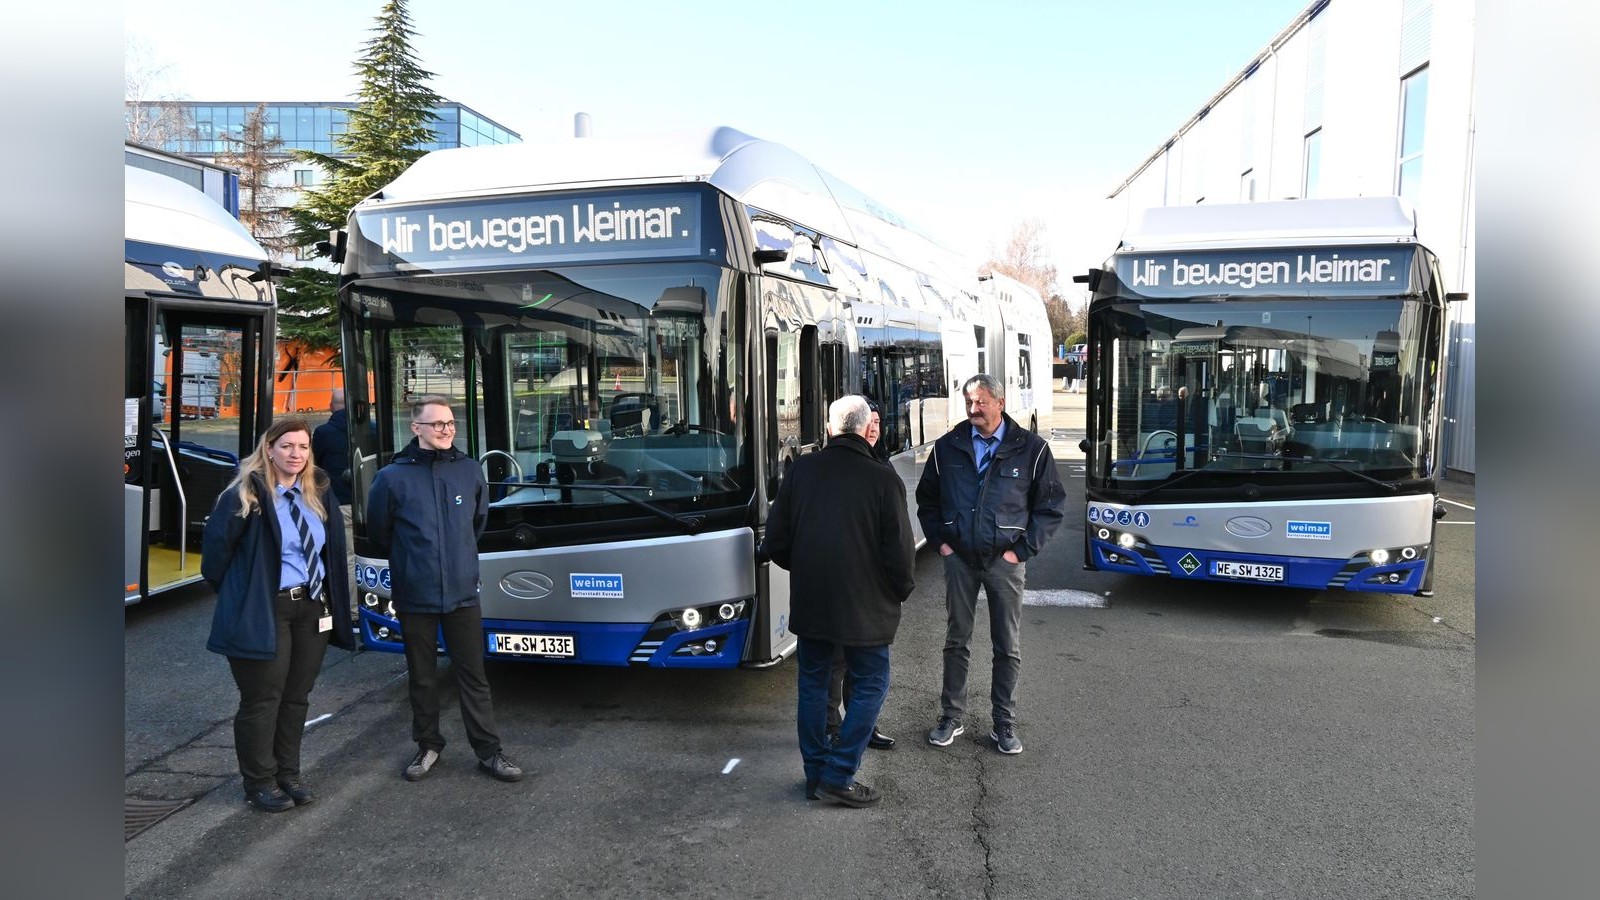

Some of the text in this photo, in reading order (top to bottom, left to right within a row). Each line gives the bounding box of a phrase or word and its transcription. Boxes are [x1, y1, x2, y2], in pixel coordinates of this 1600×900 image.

[381, 201, 689, 254] Wir bewegen Weimar.
[1132, 254, 1396, 289] Wir bewegen Weimar.
[1290, 523, 1328, 533] weimar
[1218, 563, 1282, 579] WE SW 132E
[574, 577, 619, 588] weimar
[496, 636, 573, 653] WE SW 133E
